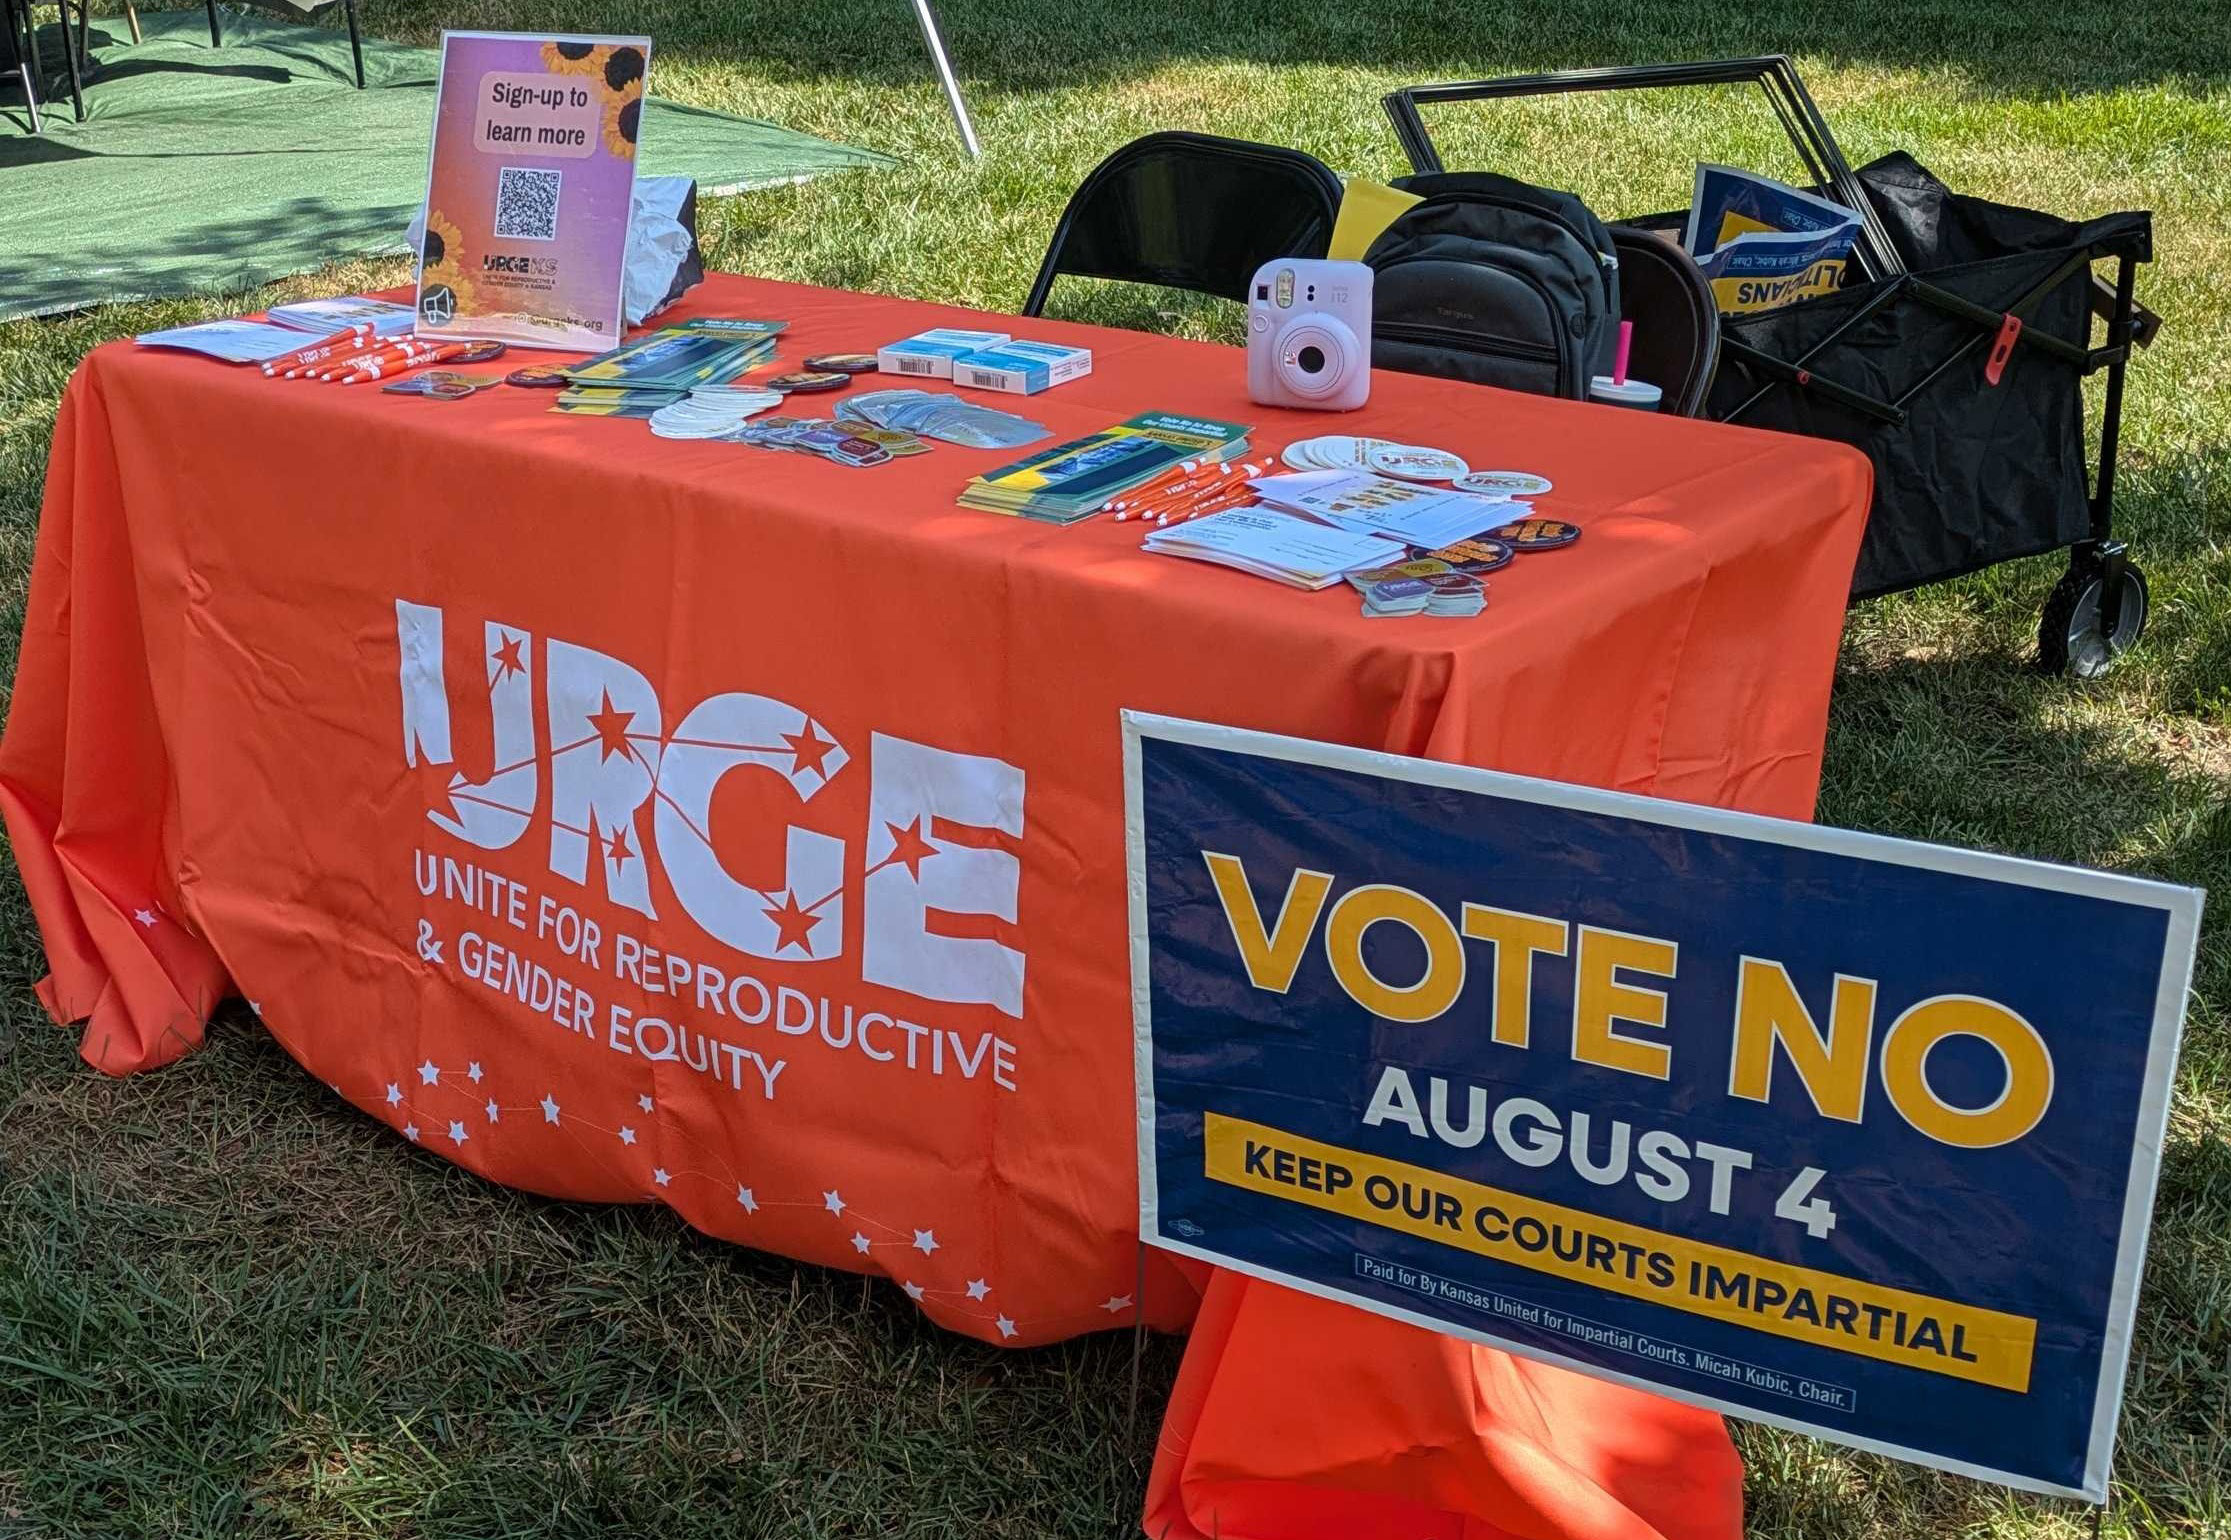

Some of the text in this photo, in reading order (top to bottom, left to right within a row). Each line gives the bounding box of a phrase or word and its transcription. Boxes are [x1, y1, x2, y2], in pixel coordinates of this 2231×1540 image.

[486, 119, 585, 145] learn more
[492, 82, 588, 110] Sign-up to
[396, 599, 1026, 1019] URGE
[414, 848, 1018, 1092] UNITE FOR REPRODUCTIVE
[416, 918, 787, 1100] & GENDER EQUITY
[1201, 849, 2055, 1149] VOTE NO
[1362, 1067, 1837, 1240] AUGUST 4
[1244, 1139, 1978, 1363] KEEP OUR COURTS IMPARTIAL
[1363, 1259, 1846, 1407] Paid for By Kansas United for Impartial Courts. Micah Kubic, Chair.
